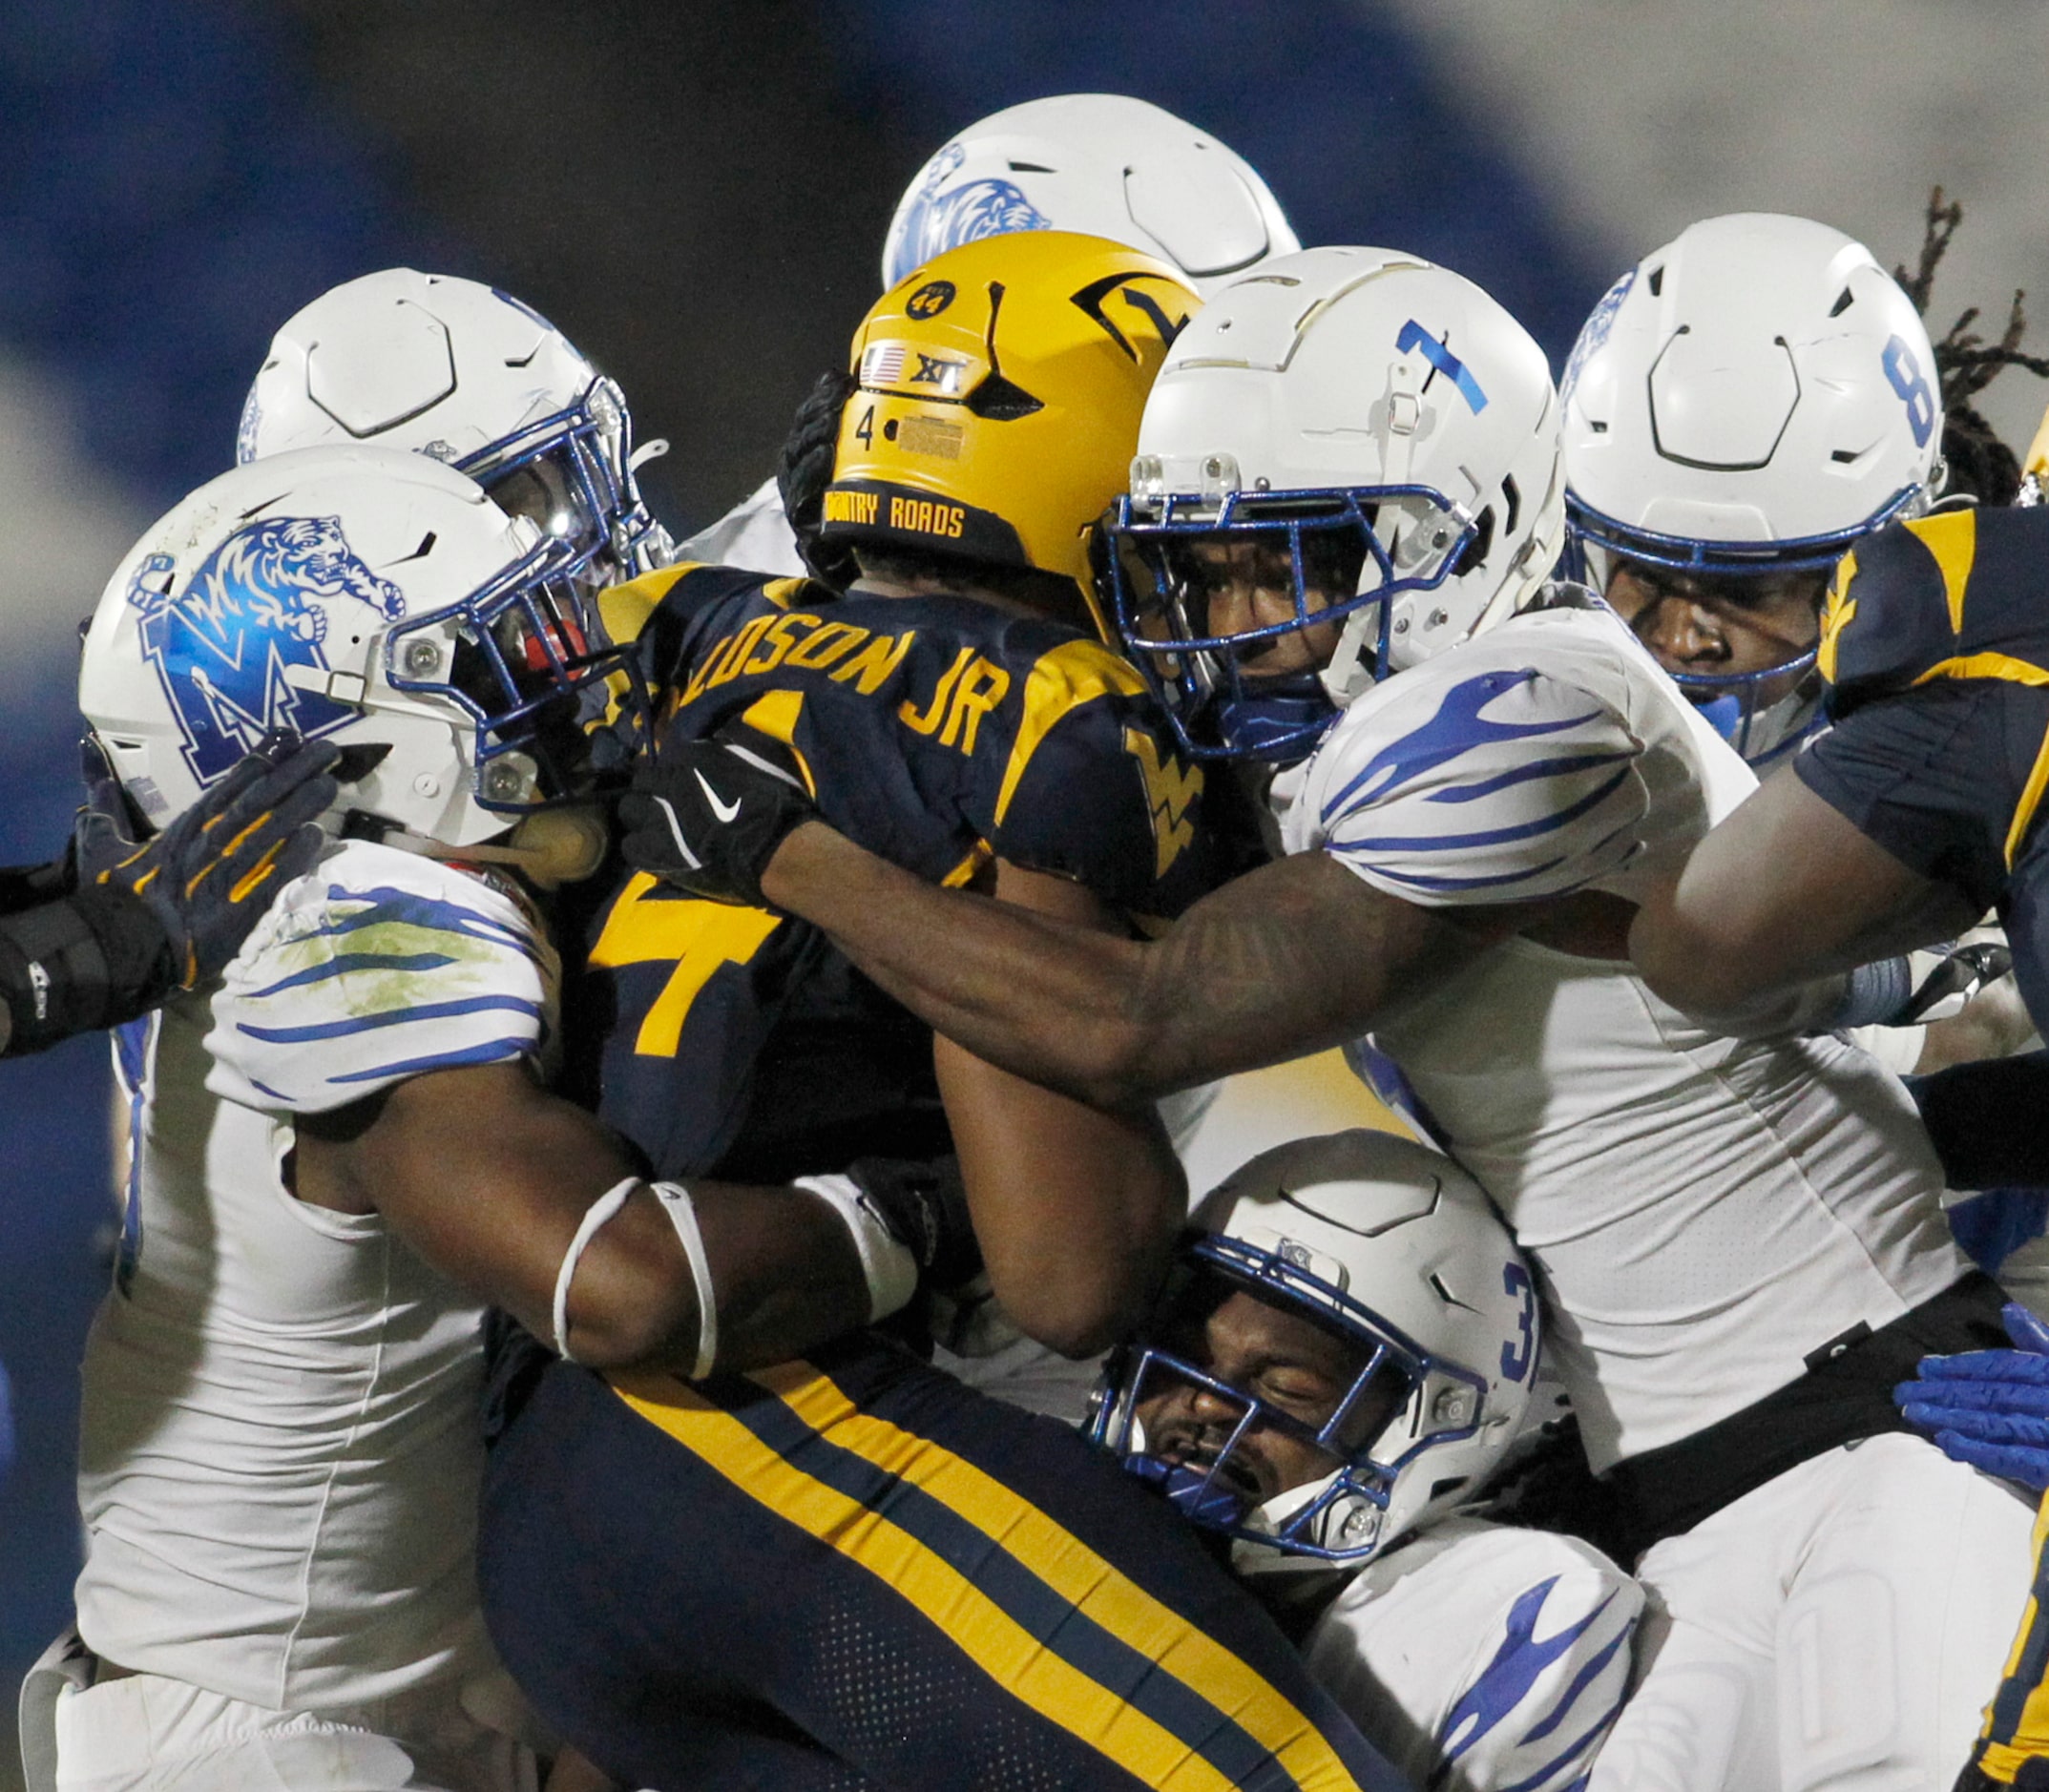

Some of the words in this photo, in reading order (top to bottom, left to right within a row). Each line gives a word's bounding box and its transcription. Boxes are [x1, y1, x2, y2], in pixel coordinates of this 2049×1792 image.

[910, 292, 945, 314] 44
[1394, 318, 1489, 416] 7
[1880, 333, 1934, 449] 8
[855, 404, 875, 452] 4
[889, 496, 966, 539] ROADS
[898, 646, 1011, 756] JR
[1499, 1261, 1535, 1383] 3
